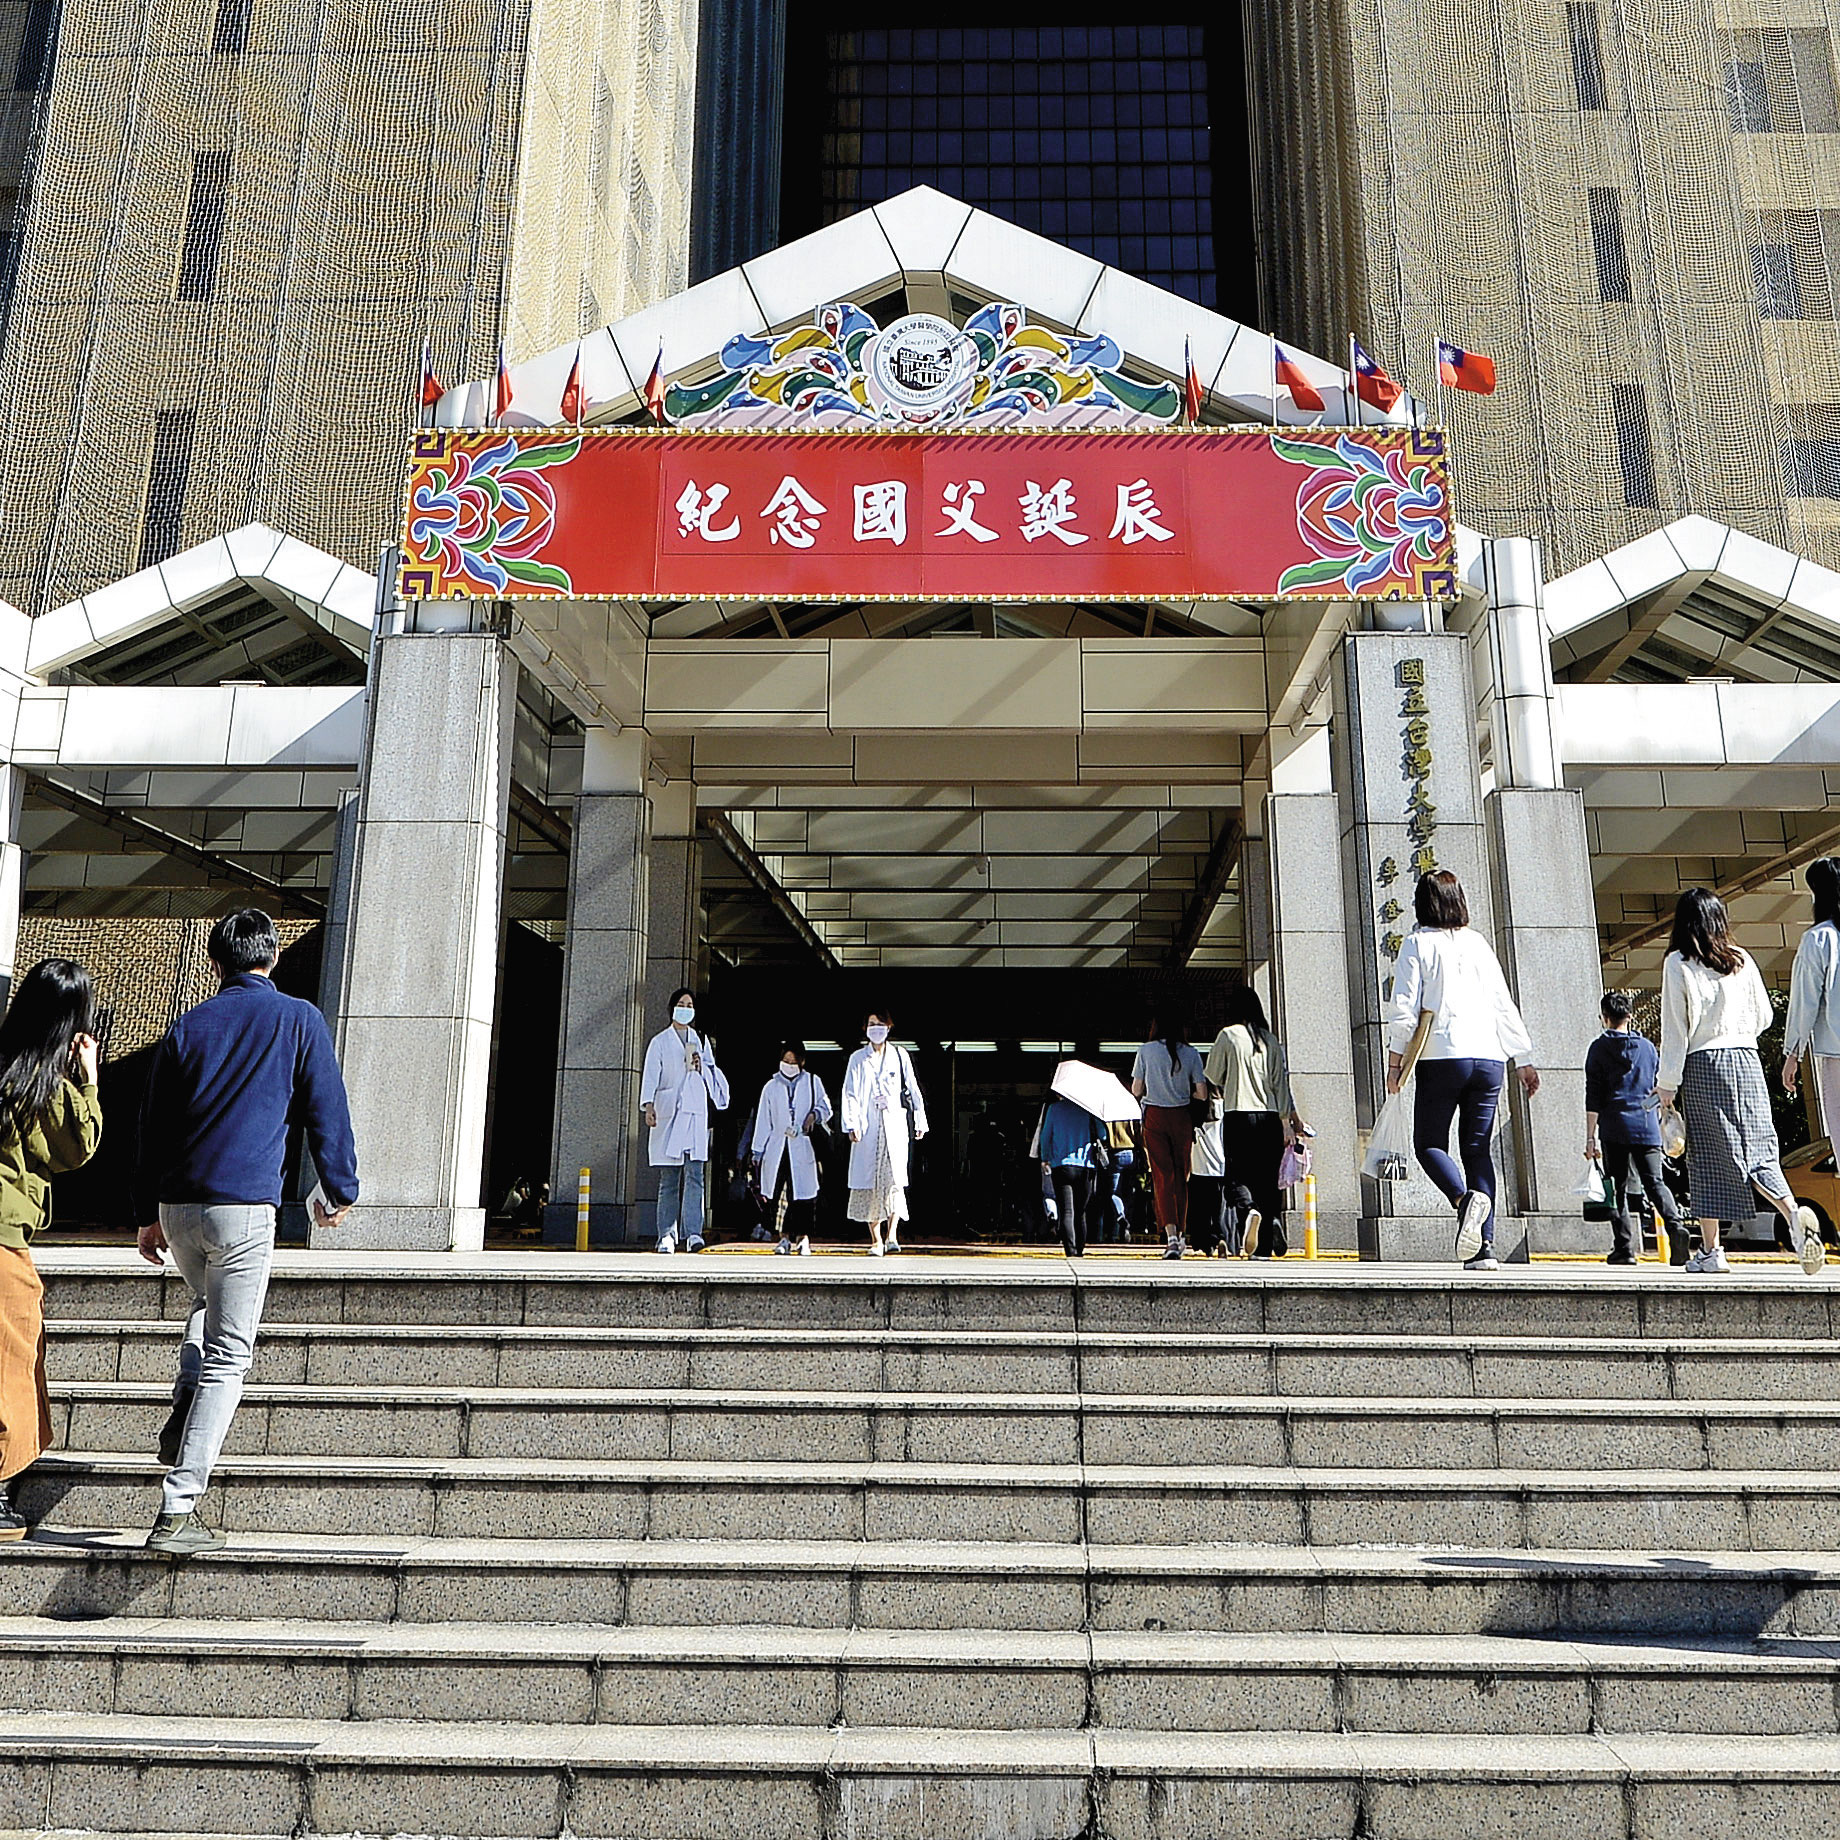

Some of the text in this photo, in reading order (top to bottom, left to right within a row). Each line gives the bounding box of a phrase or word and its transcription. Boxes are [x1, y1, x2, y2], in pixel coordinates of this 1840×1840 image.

[674, 475, 1177, 548] 紀念國父誕辰
